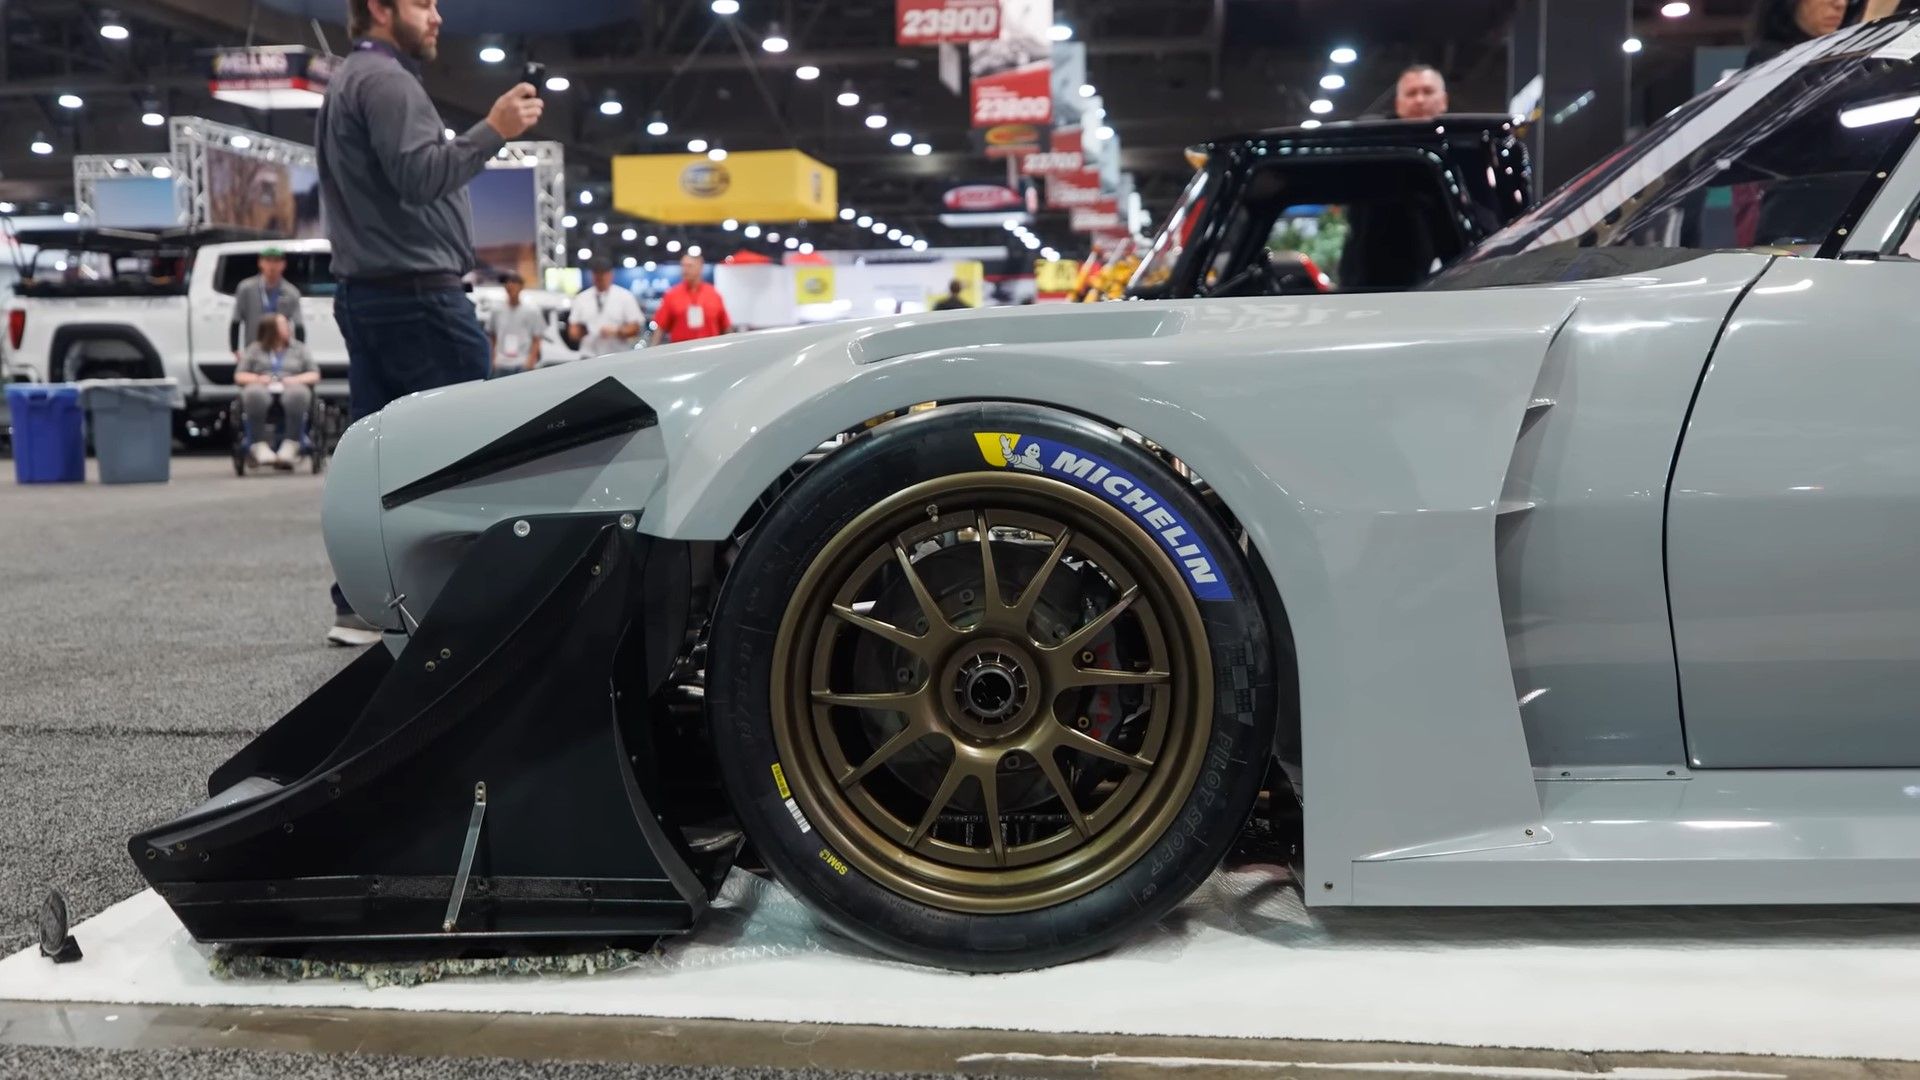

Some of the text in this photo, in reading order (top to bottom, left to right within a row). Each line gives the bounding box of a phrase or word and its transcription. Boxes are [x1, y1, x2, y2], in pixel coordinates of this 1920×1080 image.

[902, 8, 998, 36] 23900
[1051, 451, 1217, 583] MICHELIN
[1151, 732, 1233, 876] PILOT SPORT
